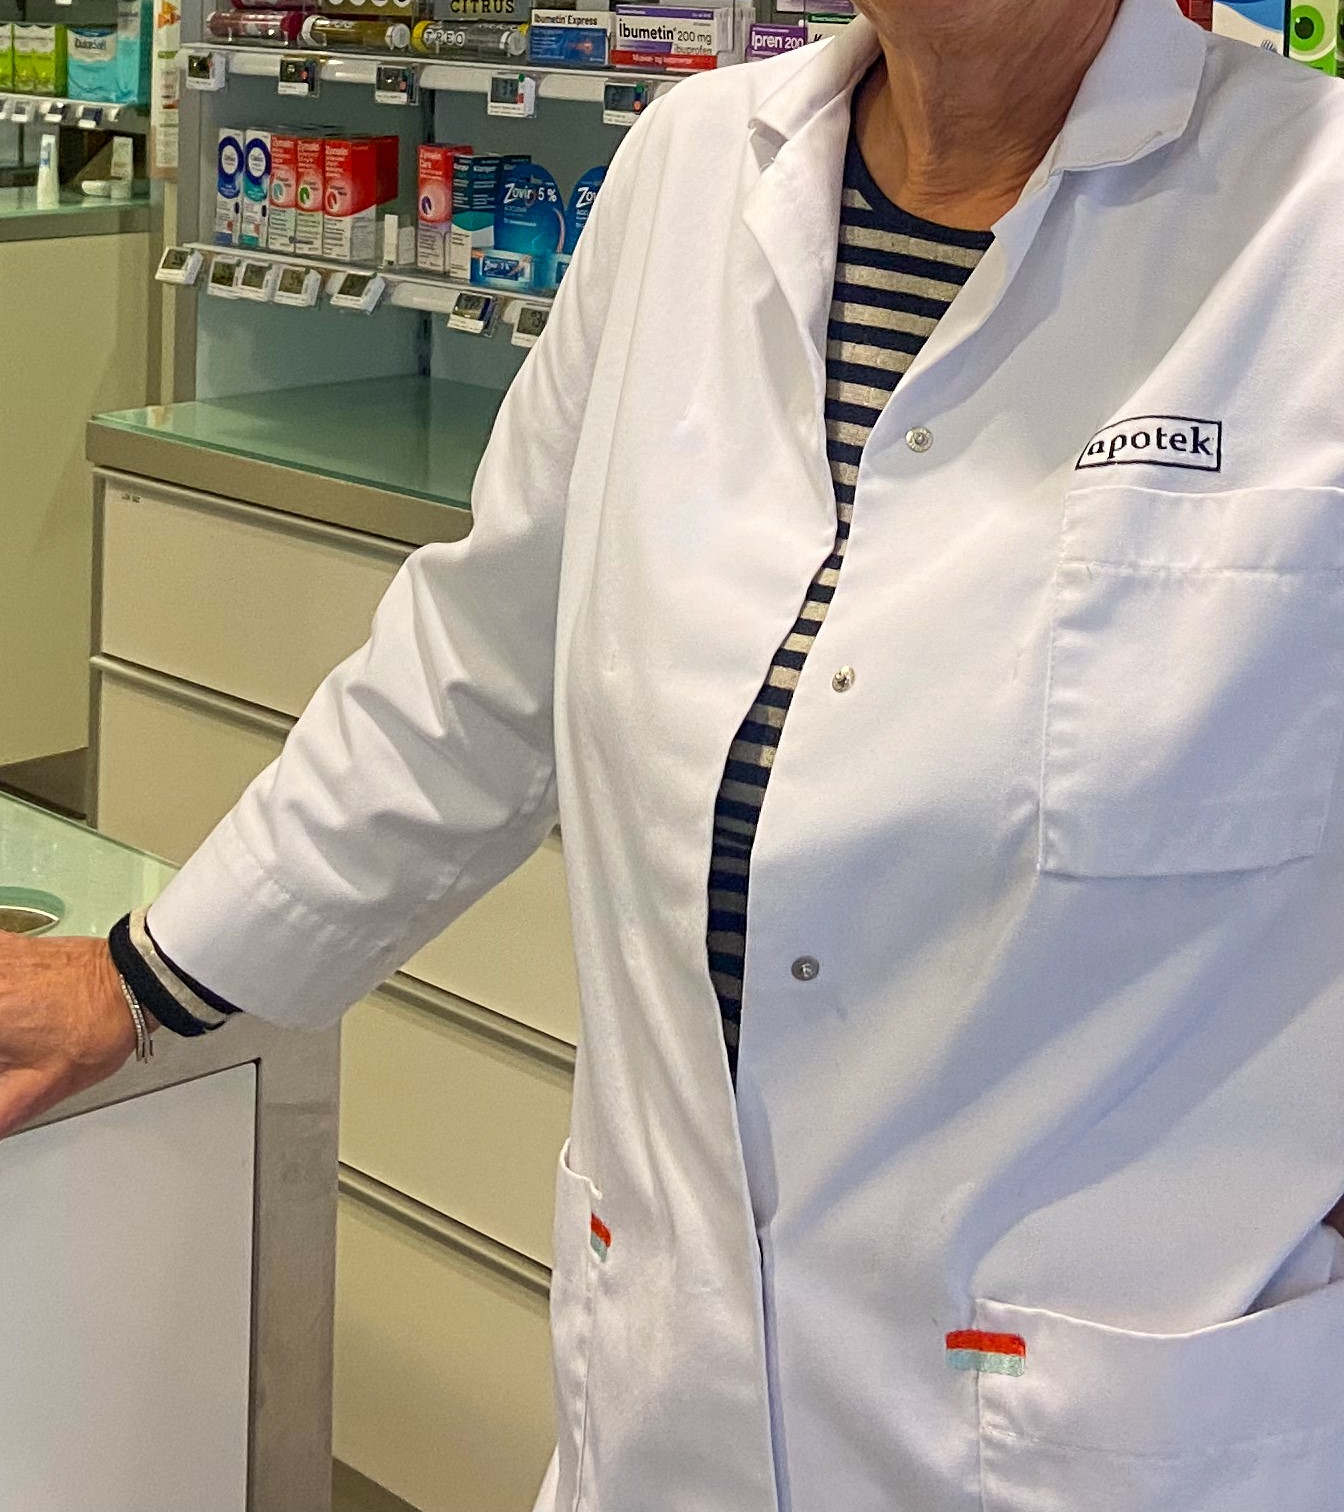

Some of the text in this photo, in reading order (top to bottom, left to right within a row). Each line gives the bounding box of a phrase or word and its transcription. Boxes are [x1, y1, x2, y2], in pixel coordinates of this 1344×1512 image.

[751, 31, 804, 50] Ipren 200
[538, 187, 545, 200] 5
[547, 188, 557, 202] %
[1087, 426, 1214, 459] apotek
